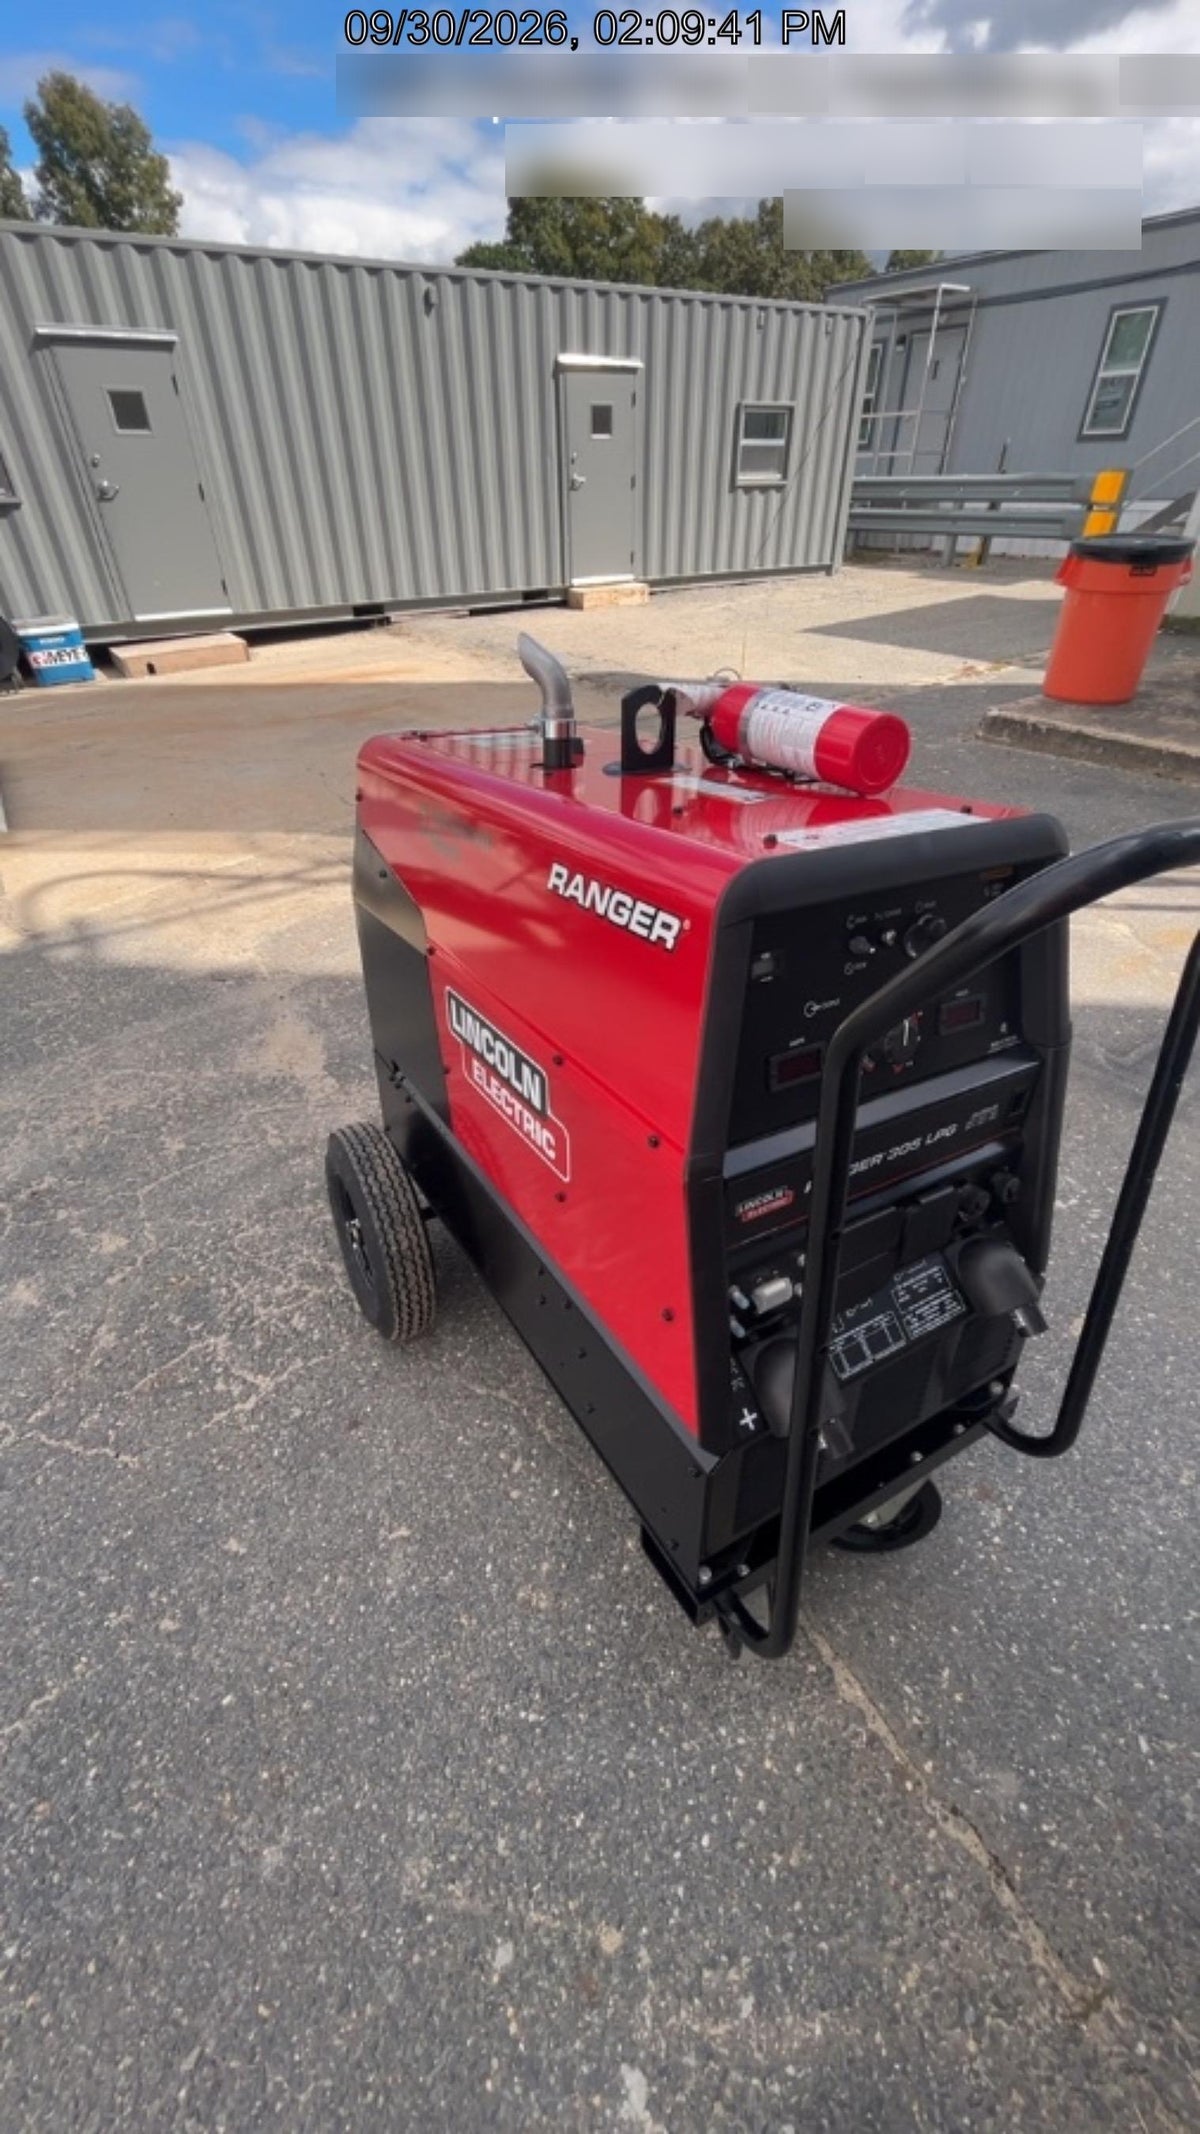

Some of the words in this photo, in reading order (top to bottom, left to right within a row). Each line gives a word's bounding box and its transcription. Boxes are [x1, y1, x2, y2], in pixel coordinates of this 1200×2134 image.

[547, 862, 682, 951] RANGER
[449, 997, 542, 1111] LINCOLN
[471, 1058, 556, 1161] ELECTRIC
